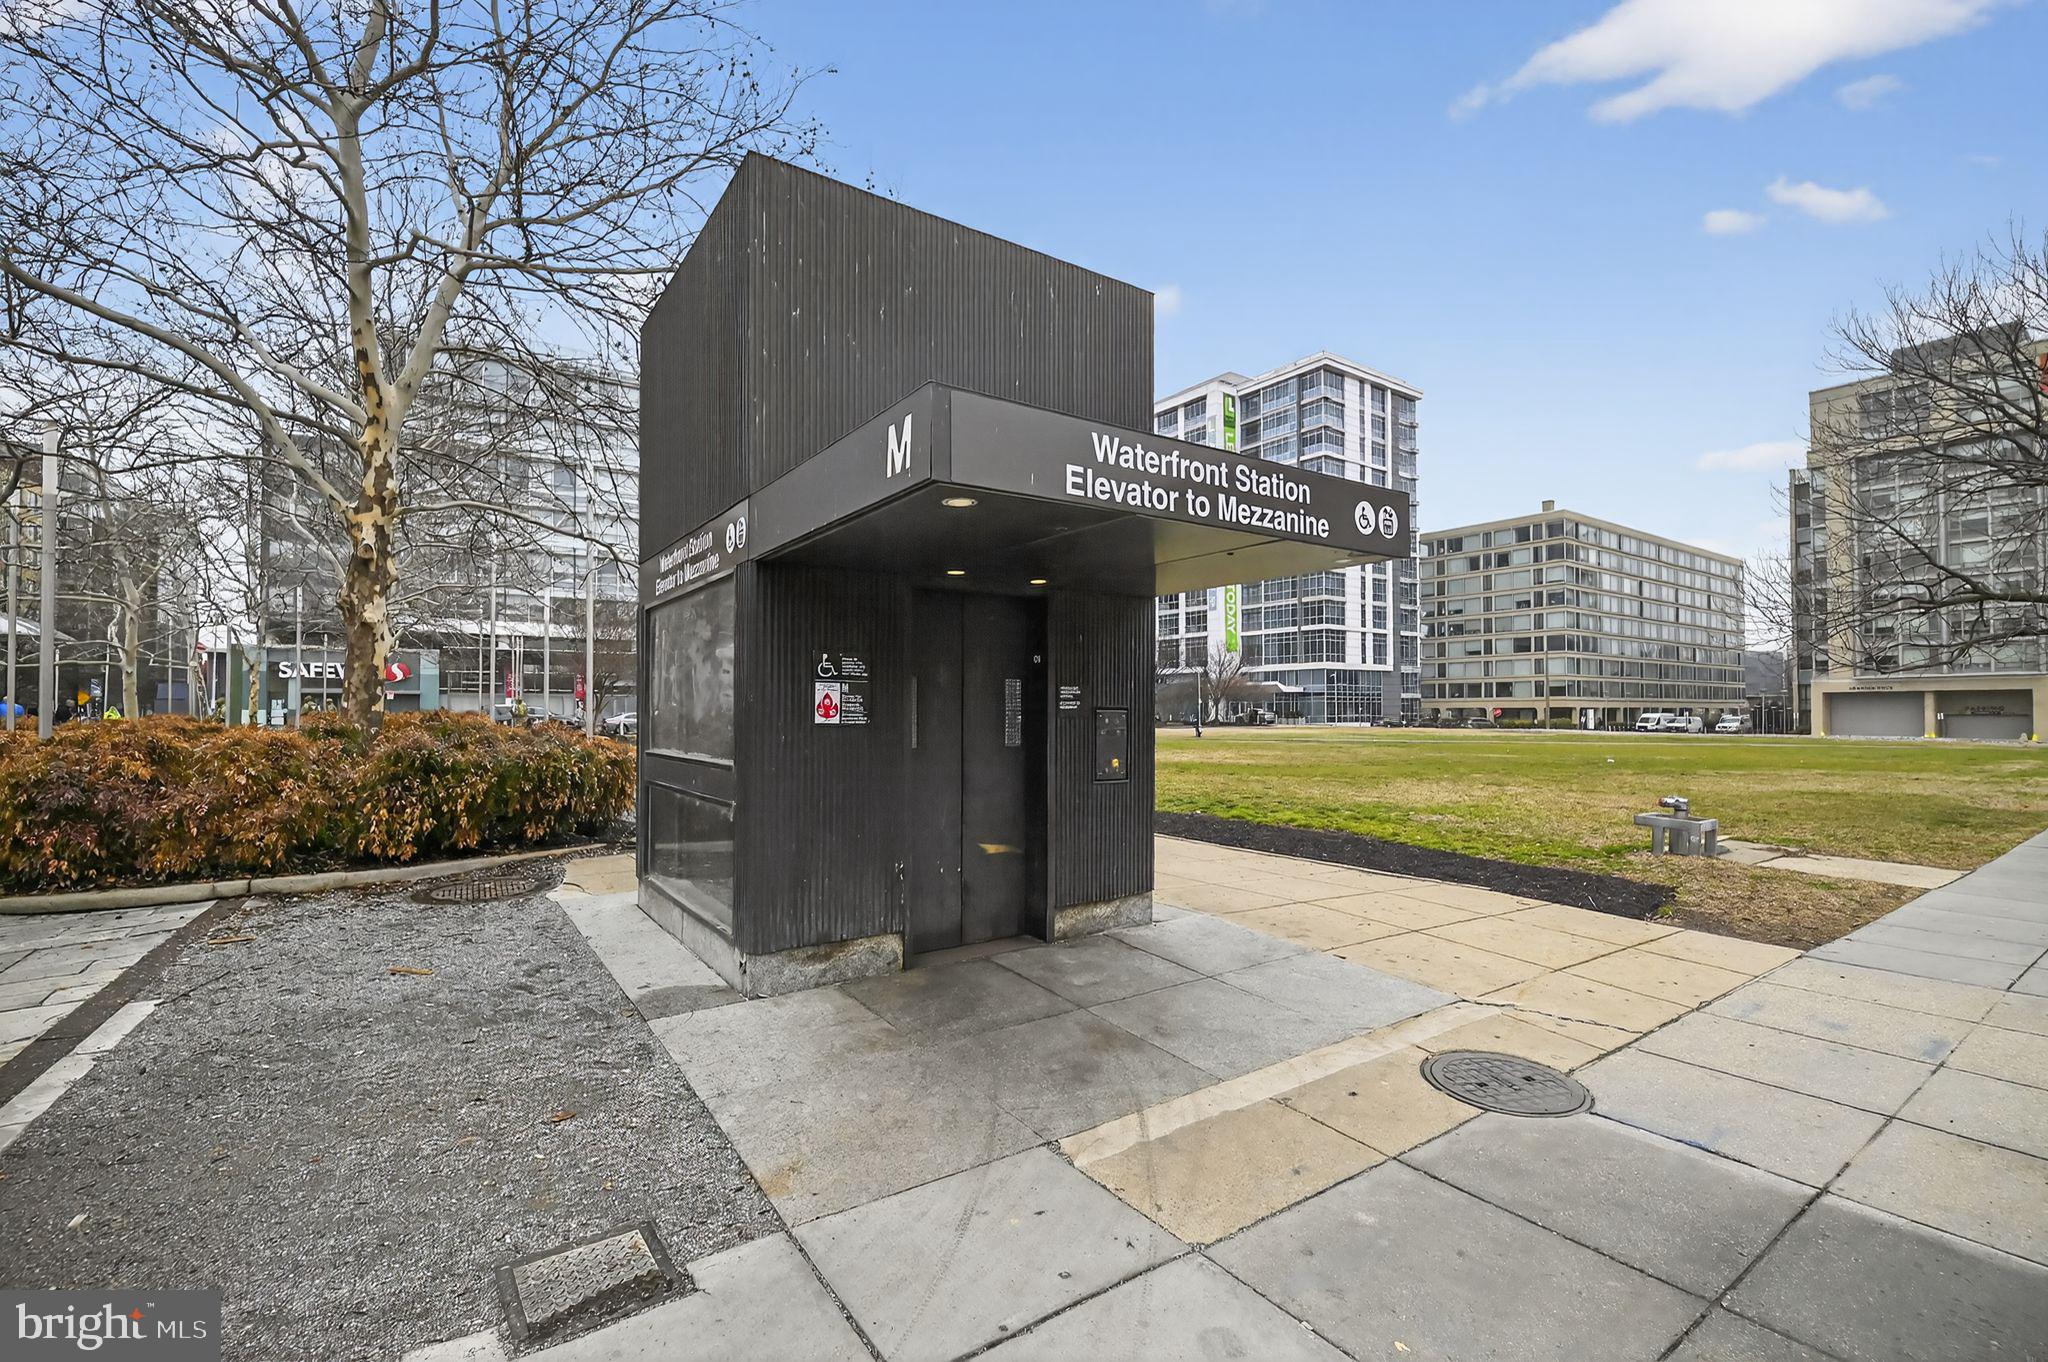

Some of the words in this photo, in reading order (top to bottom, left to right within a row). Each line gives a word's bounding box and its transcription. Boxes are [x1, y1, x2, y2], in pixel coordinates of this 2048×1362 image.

[886, 412, 912, 478] M
[1091, 431, 1229, 488] Waterfront
[1235, 464, 1311, 504] Station
[1066, 463, 1179, 512] Elevator
[1186, 488, 1211, 518] to
[1218, 493, 1330, 538] Mezzanine
[278, 661, 345, 679] SAFE
